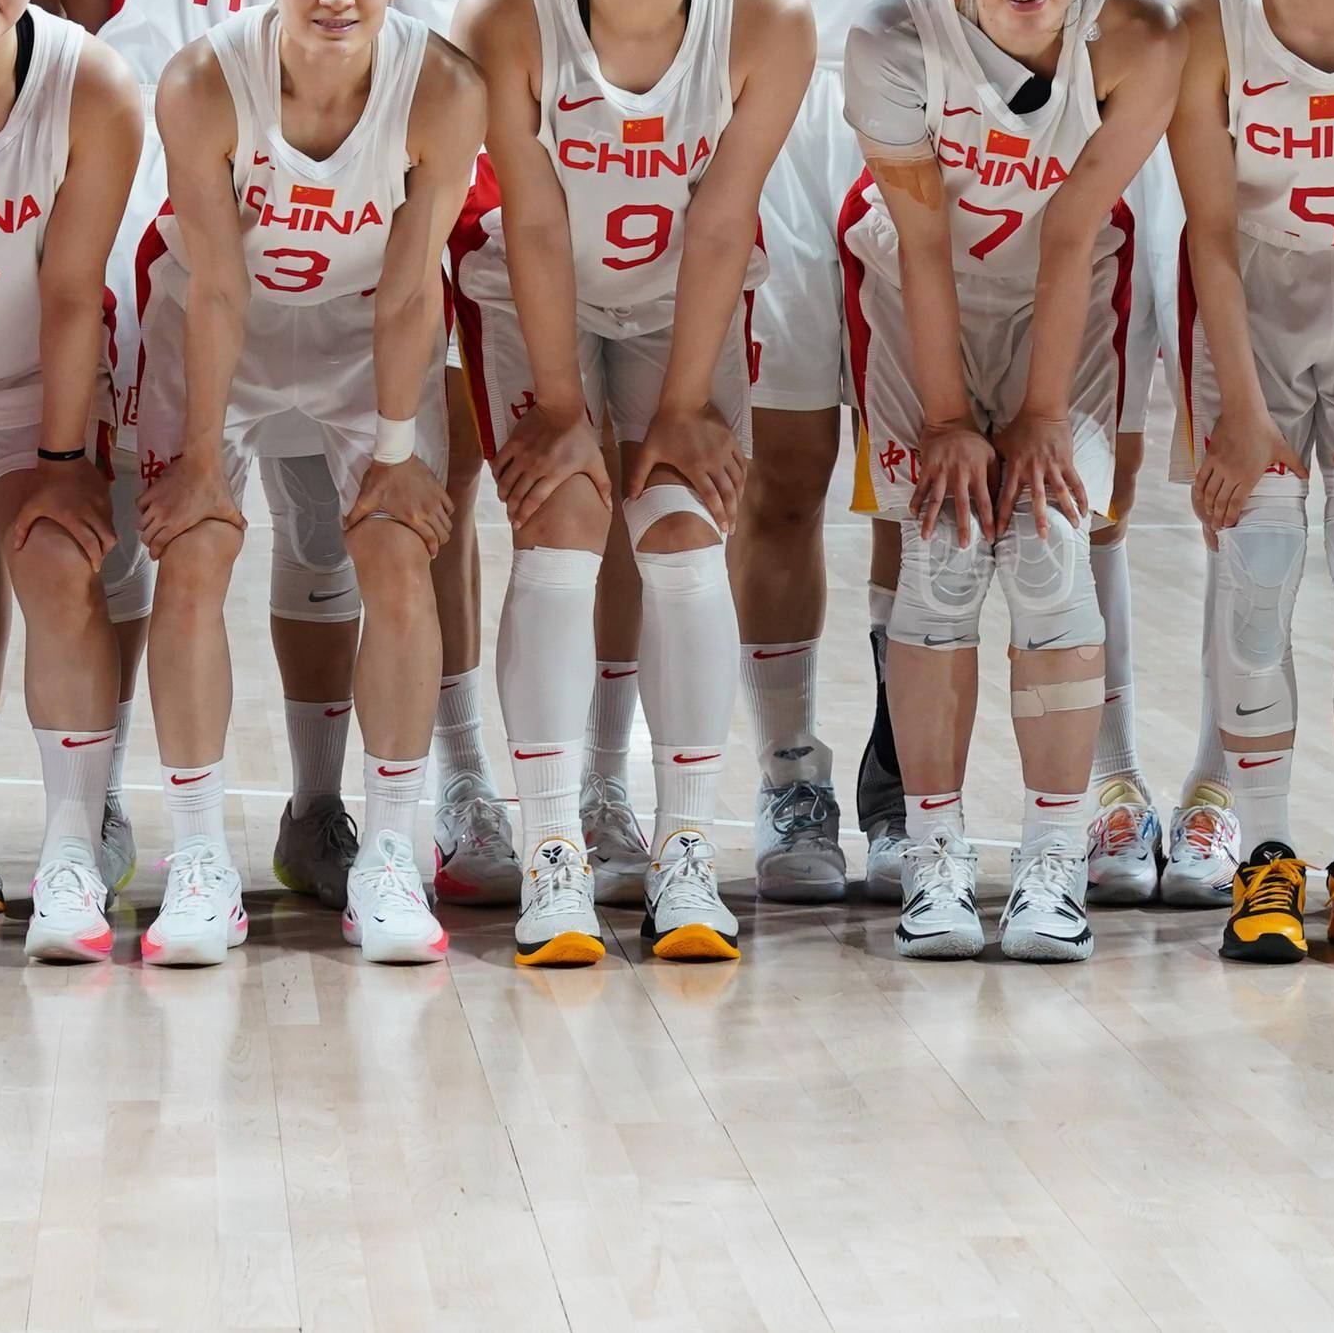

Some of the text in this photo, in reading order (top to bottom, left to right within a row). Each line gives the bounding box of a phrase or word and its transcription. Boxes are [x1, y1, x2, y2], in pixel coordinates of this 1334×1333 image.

[557, 135, 711, 178] CHINA
[937, 136, 1069, 191] CHINA
[602, 203, 674, 271] 9
[958, 197, 1023, 261] 7
[254, 248, 331, 292] 3
